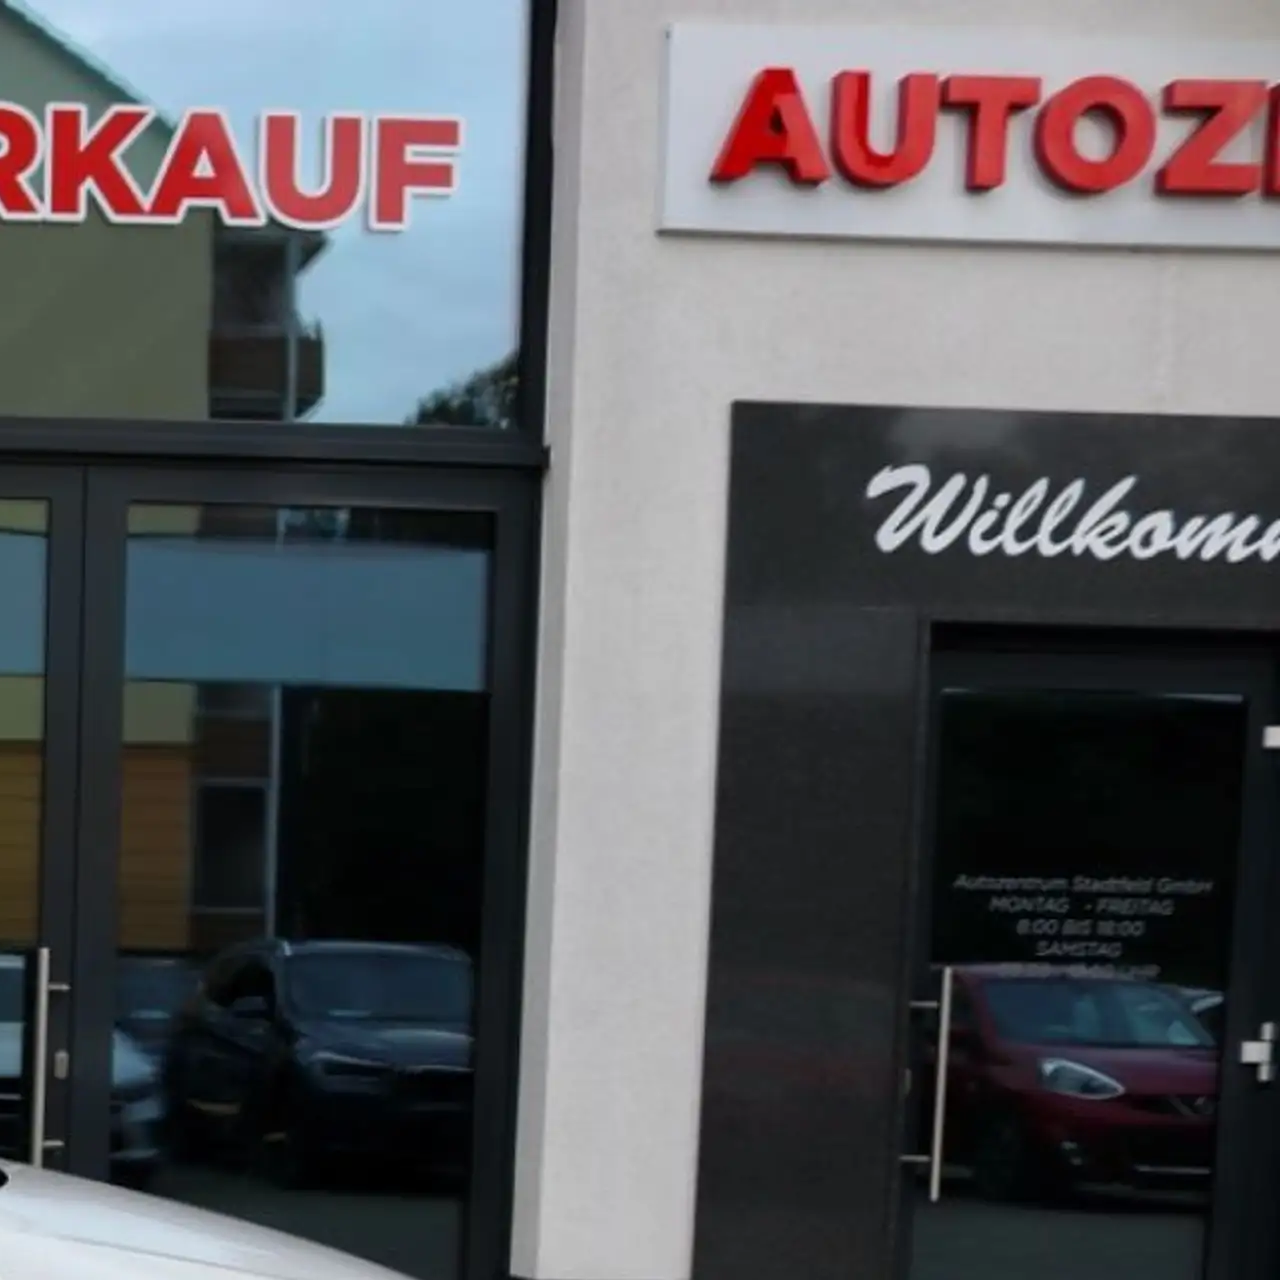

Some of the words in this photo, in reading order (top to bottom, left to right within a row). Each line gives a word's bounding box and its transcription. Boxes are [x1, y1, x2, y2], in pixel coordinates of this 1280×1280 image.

[708, 66, 1280, 199] AUTOZ
[867, 465, 1280, 562] Willkom
[990, 897, 1070, 913] MONTAG
[1096, 898, 1175, 915] FREITAG
[1035, 940, 1123, 957] SAMSTAG
